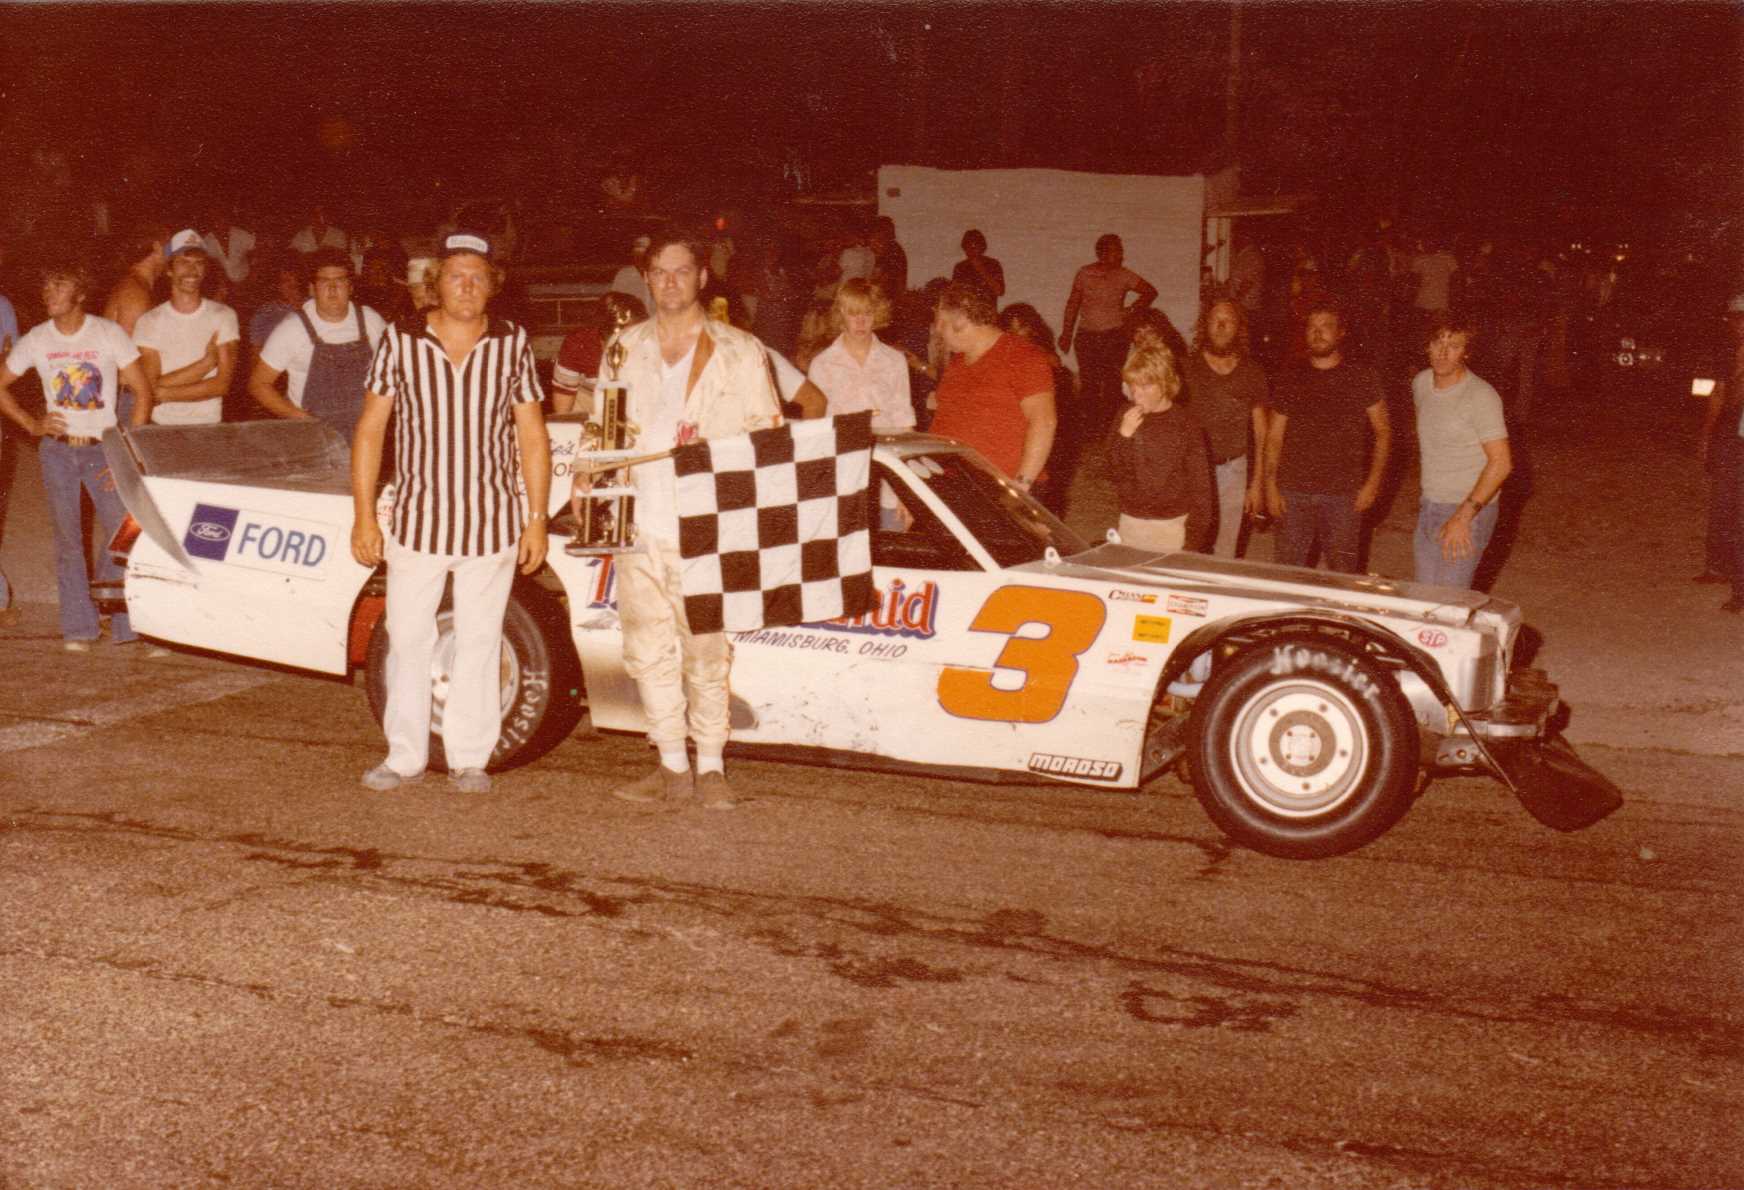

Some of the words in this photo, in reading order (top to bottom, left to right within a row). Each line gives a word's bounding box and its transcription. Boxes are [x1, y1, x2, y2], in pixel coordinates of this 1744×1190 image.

[237, 522, 326, 567] FORD
[858, 640, 908, 658] OHIO
[936, 584, 1107, 724] 3
